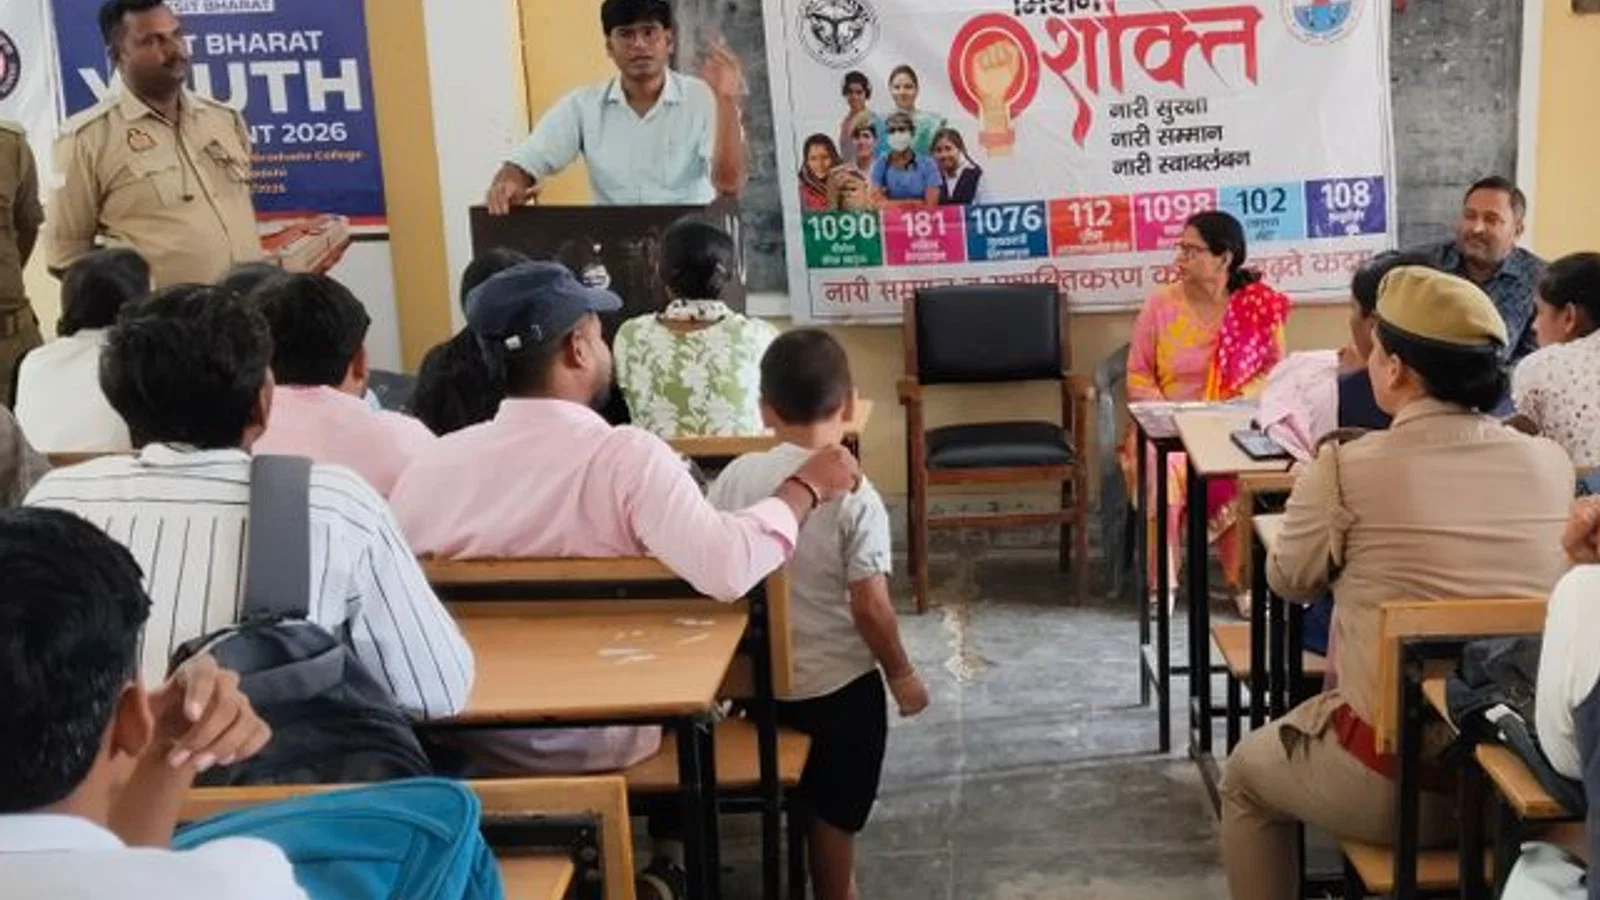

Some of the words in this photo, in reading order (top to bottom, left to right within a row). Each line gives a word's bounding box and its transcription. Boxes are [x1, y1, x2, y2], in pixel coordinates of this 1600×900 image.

[206, 31, 323, 55] BHARAT
[78, 59, 362, 114] YUTH
[281, 122, 348, 144] 2026
[1111, 123, 1151, 147] नारी
[1157, 125, 1223, 146] सम्मान
[1112, 151, 1152, 176] नारी
[1139, 192, 1212, 223] 1098
[1236, 187, 1287, 215] 102
[1321, 180, 1370, 210] 108
[807, 213, 876, 241] 1090
[902, 211, 946, 238] 181
[971, 204, 1042, 235] 1076
[1068, 199, 1113, 228] 112
